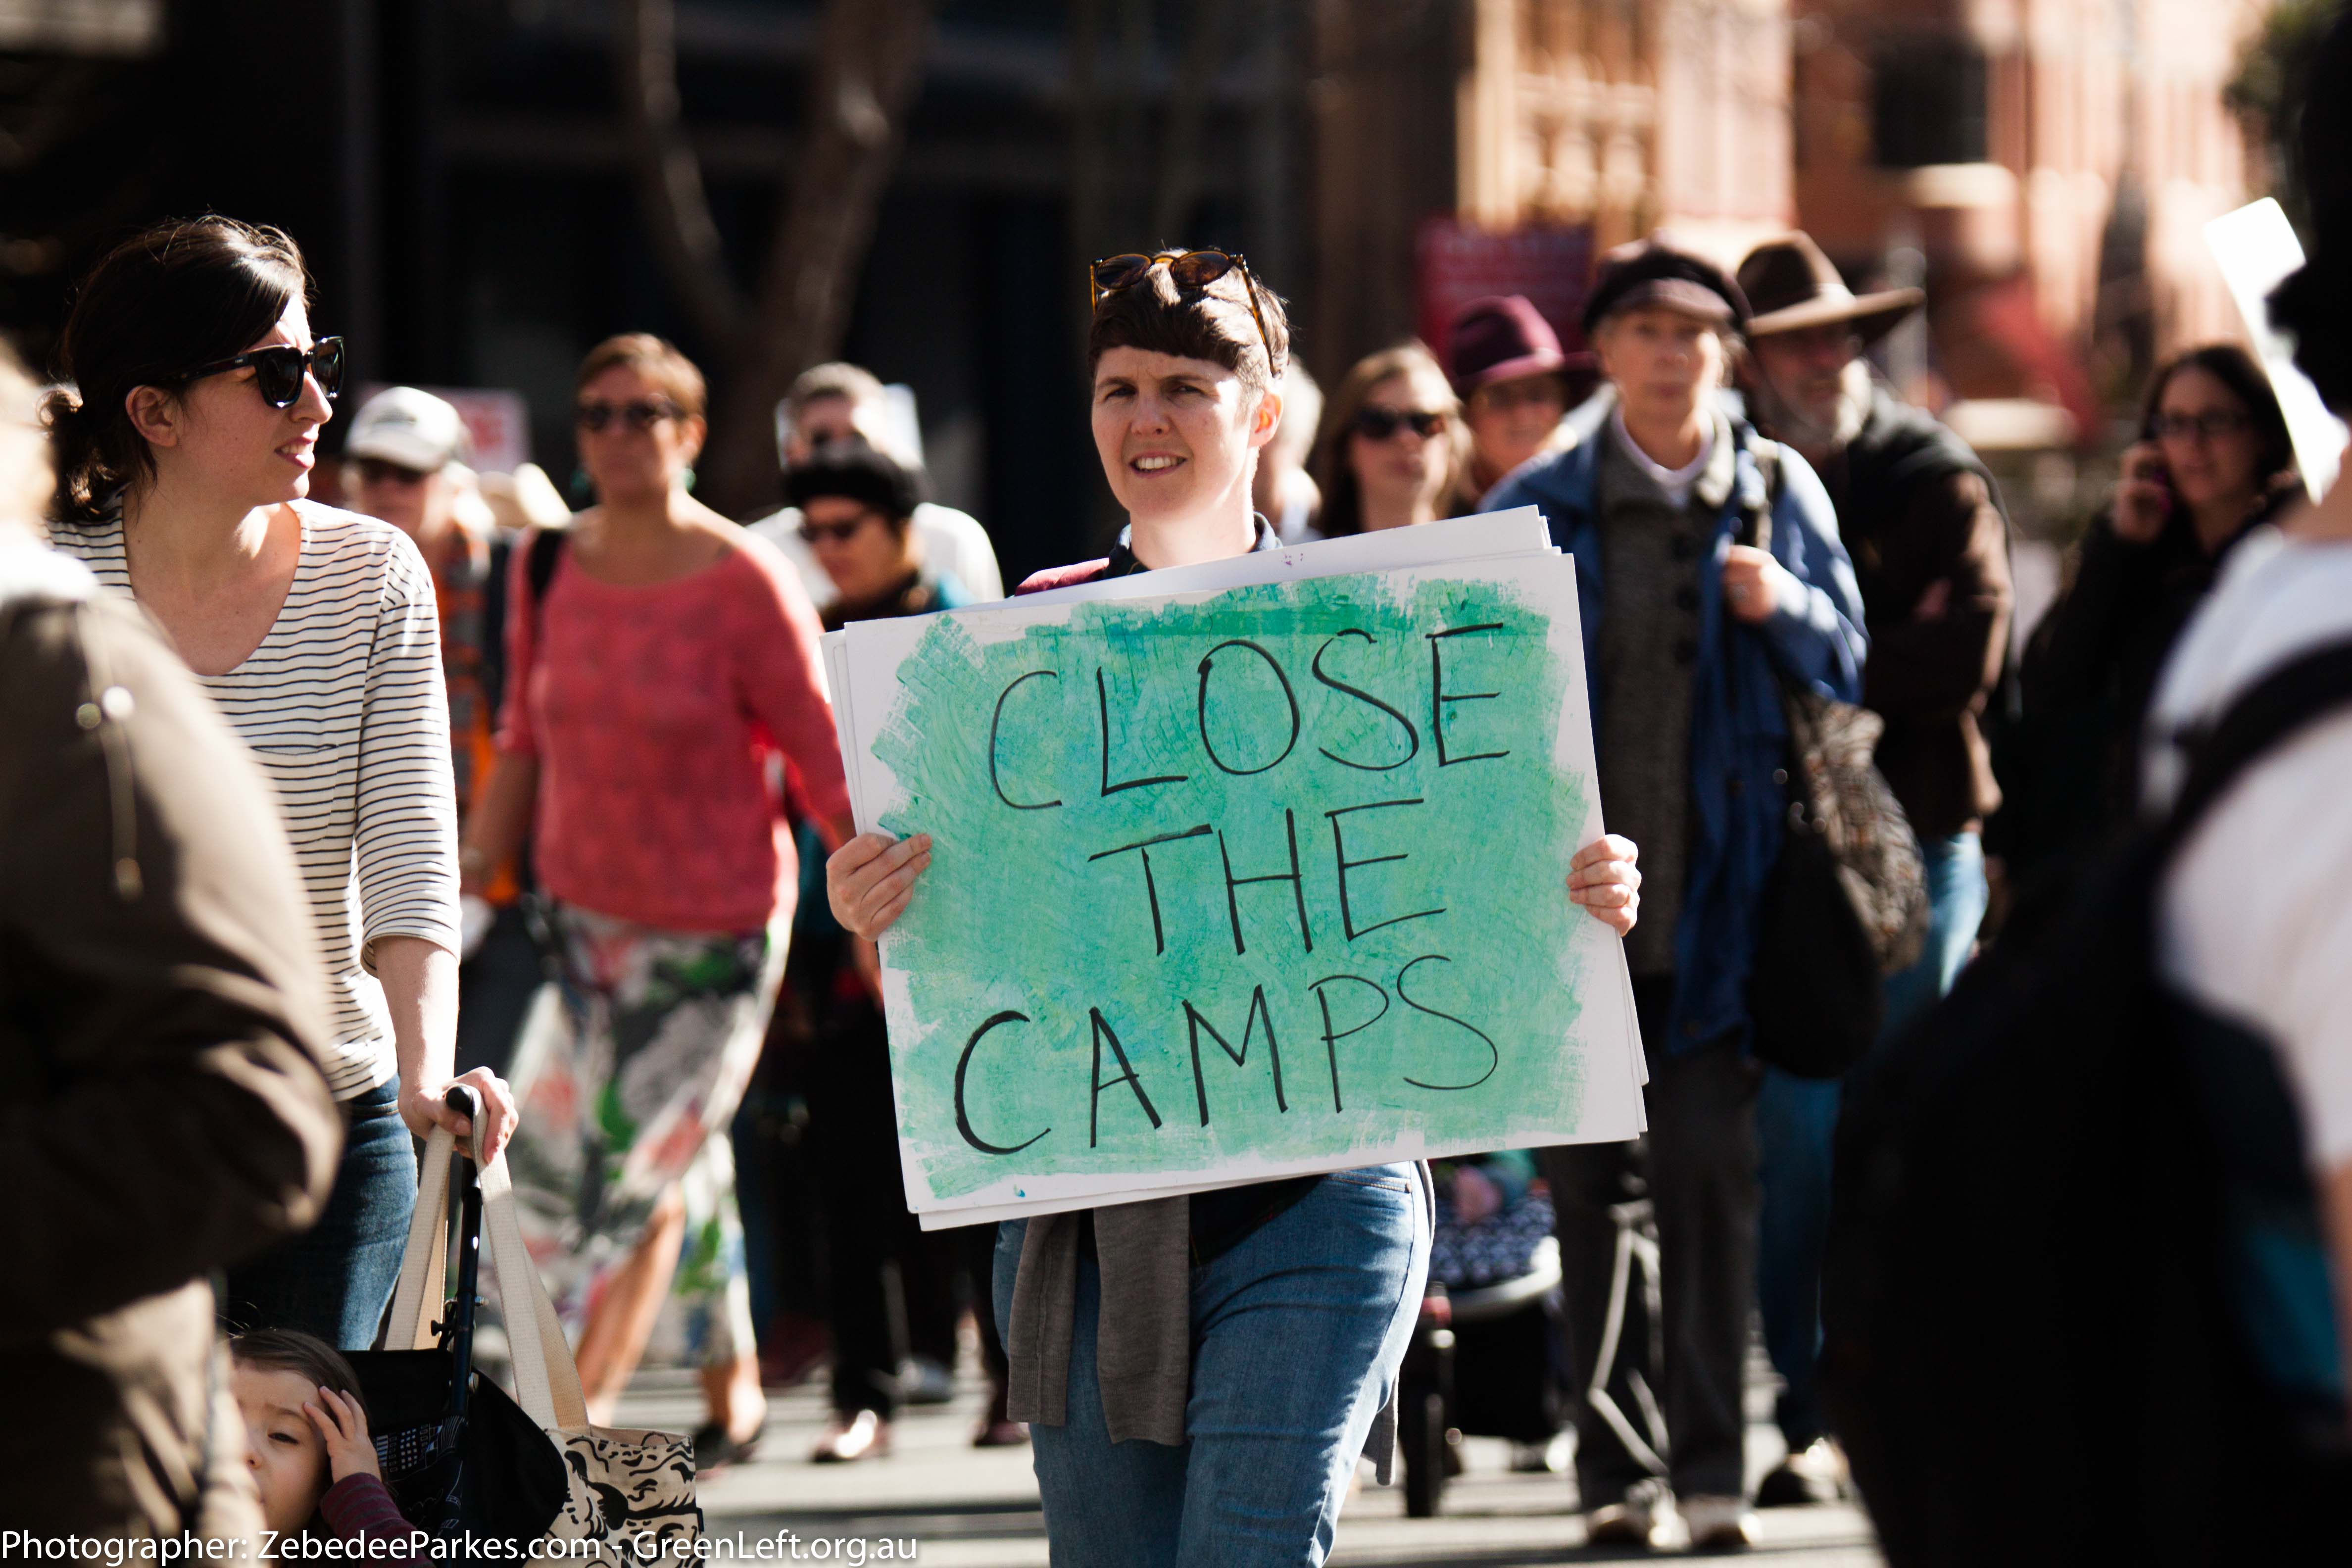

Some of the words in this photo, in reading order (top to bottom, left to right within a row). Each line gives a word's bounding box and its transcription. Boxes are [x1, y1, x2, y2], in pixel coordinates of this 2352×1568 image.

[989, 622, 1510, 810] CLOSE
[1088, 798, 1446, 956] THE
[953, 954, 1498, 1155] CAMPS
